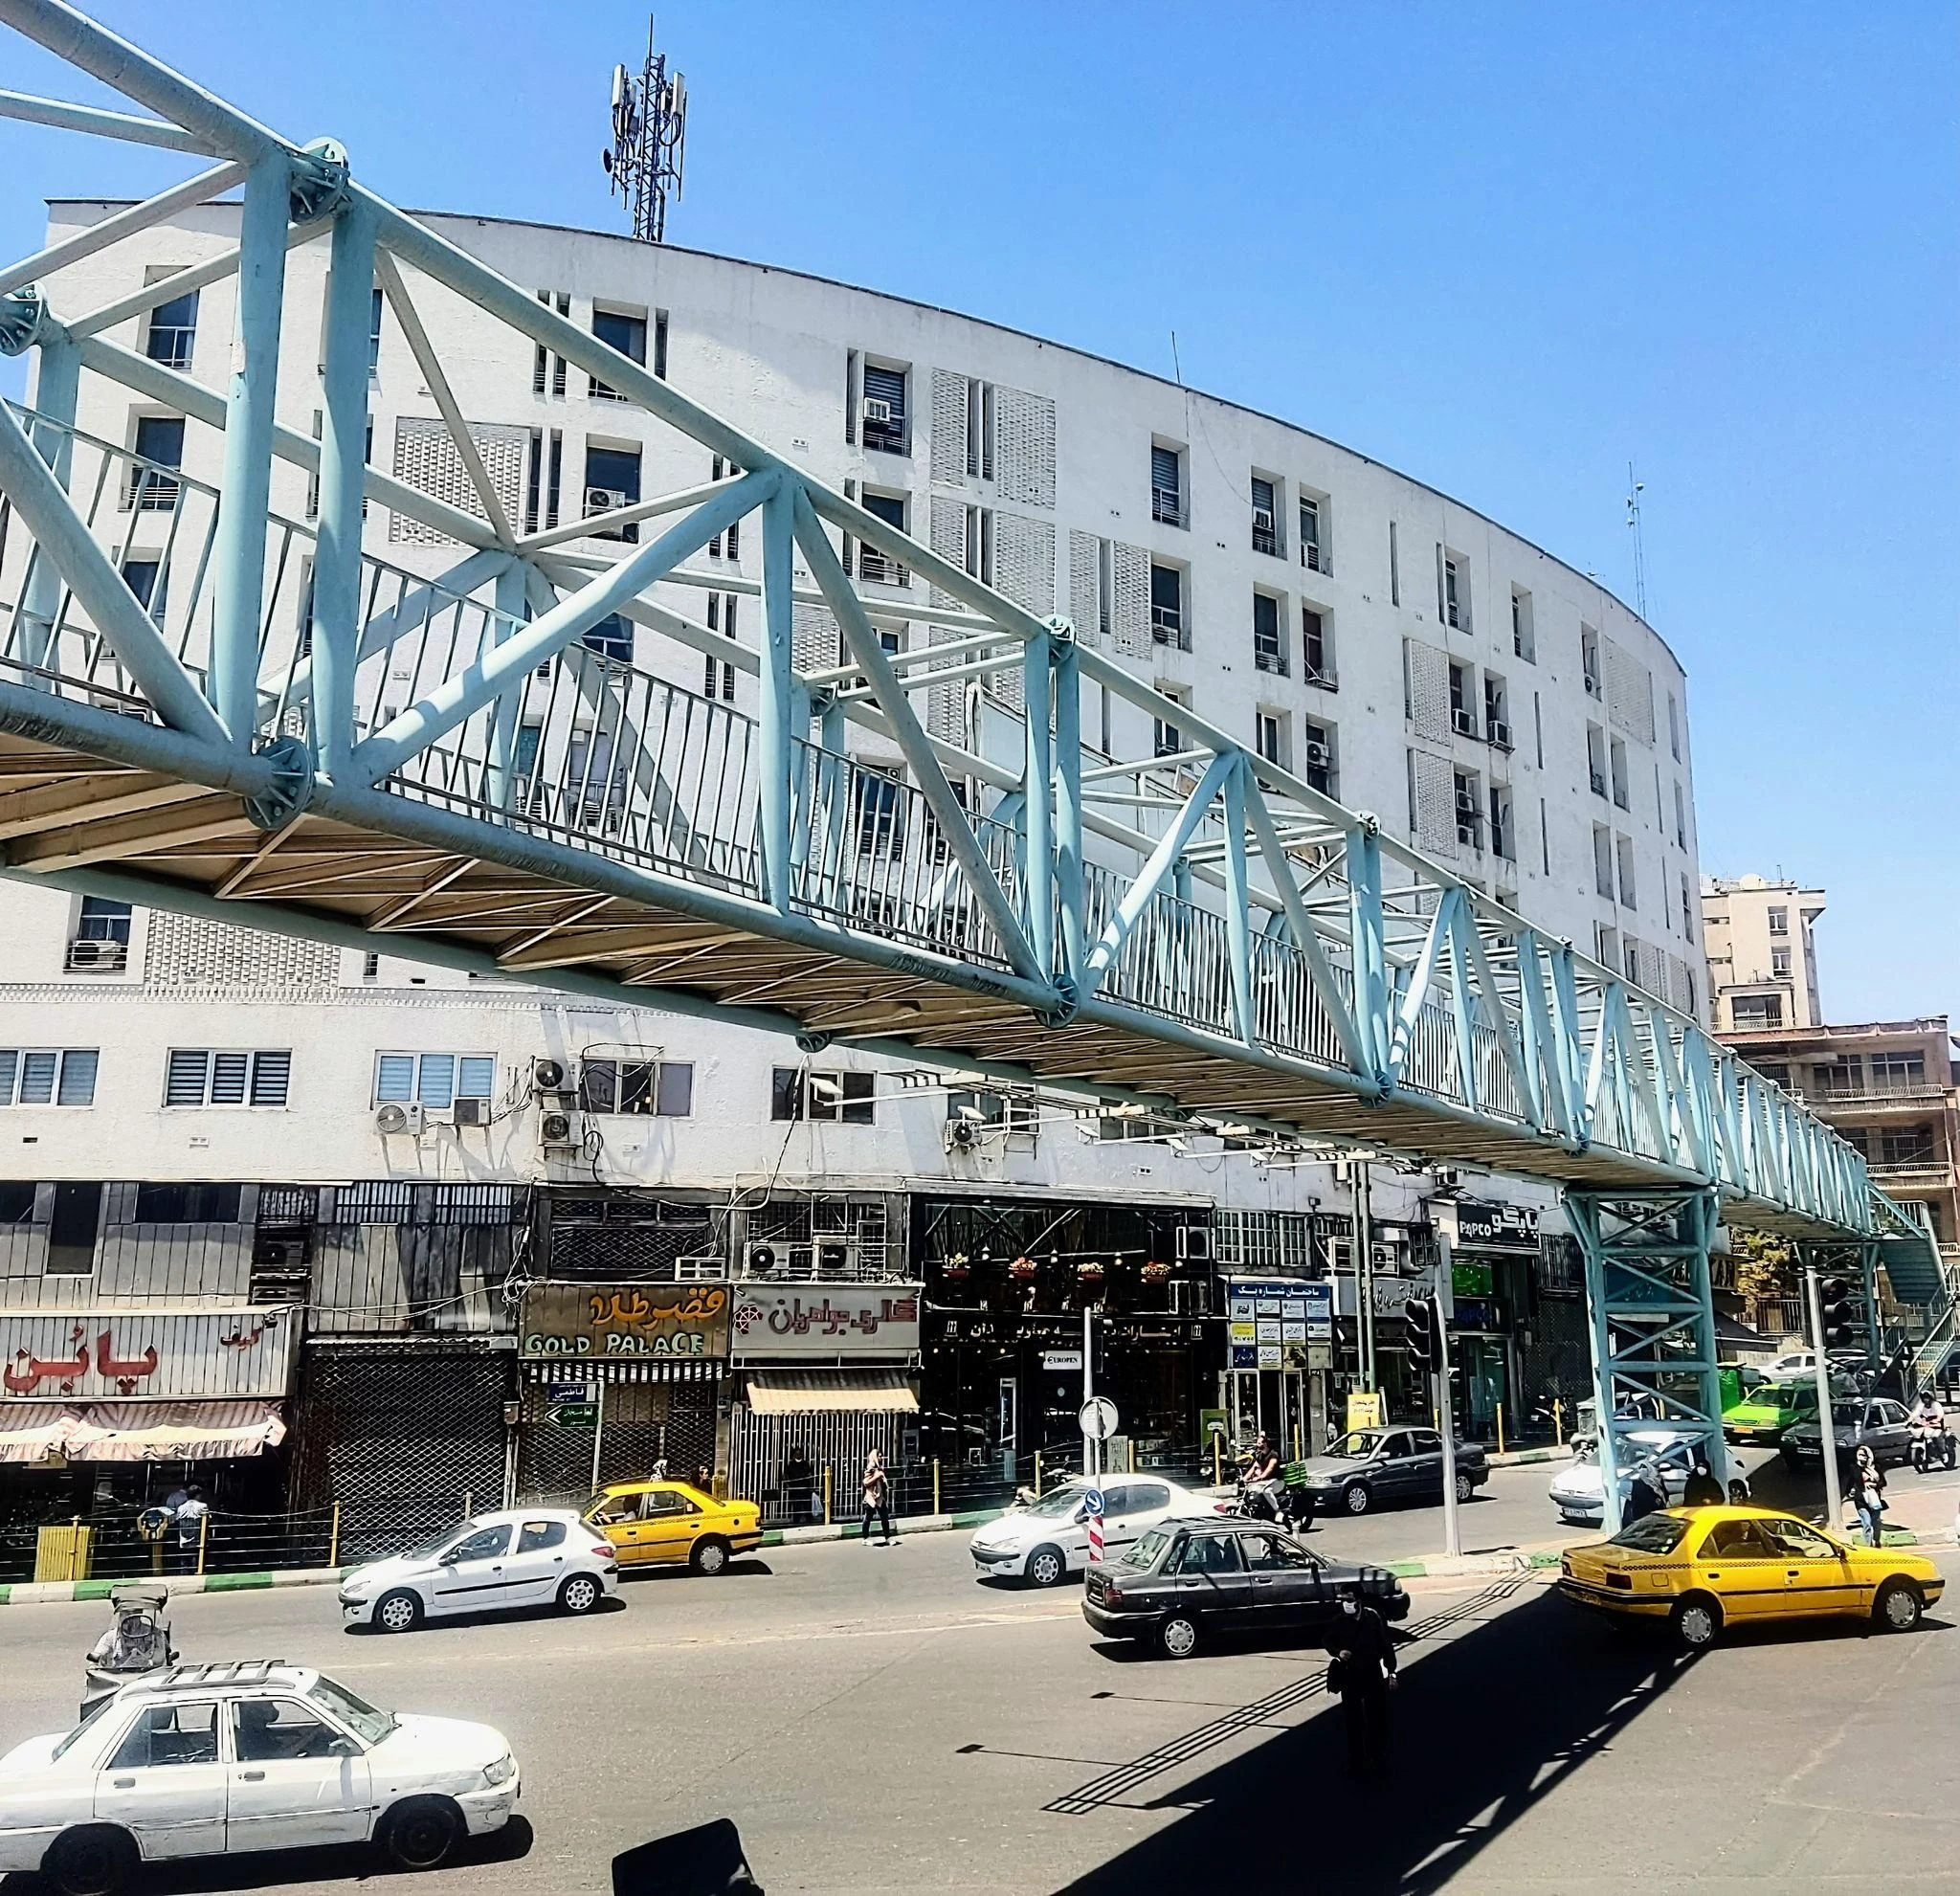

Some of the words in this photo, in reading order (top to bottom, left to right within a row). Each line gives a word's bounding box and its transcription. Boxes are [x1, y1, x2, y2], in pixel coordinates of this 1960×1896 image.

[1459, 1220, 1492, 1238] PAPCO
[1491, 1207, 1539, 1238] پاپکو
[1237, 1286, 1258, 1297] یک
[1258, 1286, 1284, 1297] شماره
[1285, 1286, 1319, 1298] ساختمان
[590, 1292, 650, 1326] طلا
[641, 1287, 725, 1330] قصر
[768, 1298, 851, 1336] جواهریان
[850, 1298, 918, 1335] گالری
[525, 1333, 590, 1354] GOLD
[606, 1332, 704, 1354] PALACE
[554, 1387, 585, 1398] فاطمی
